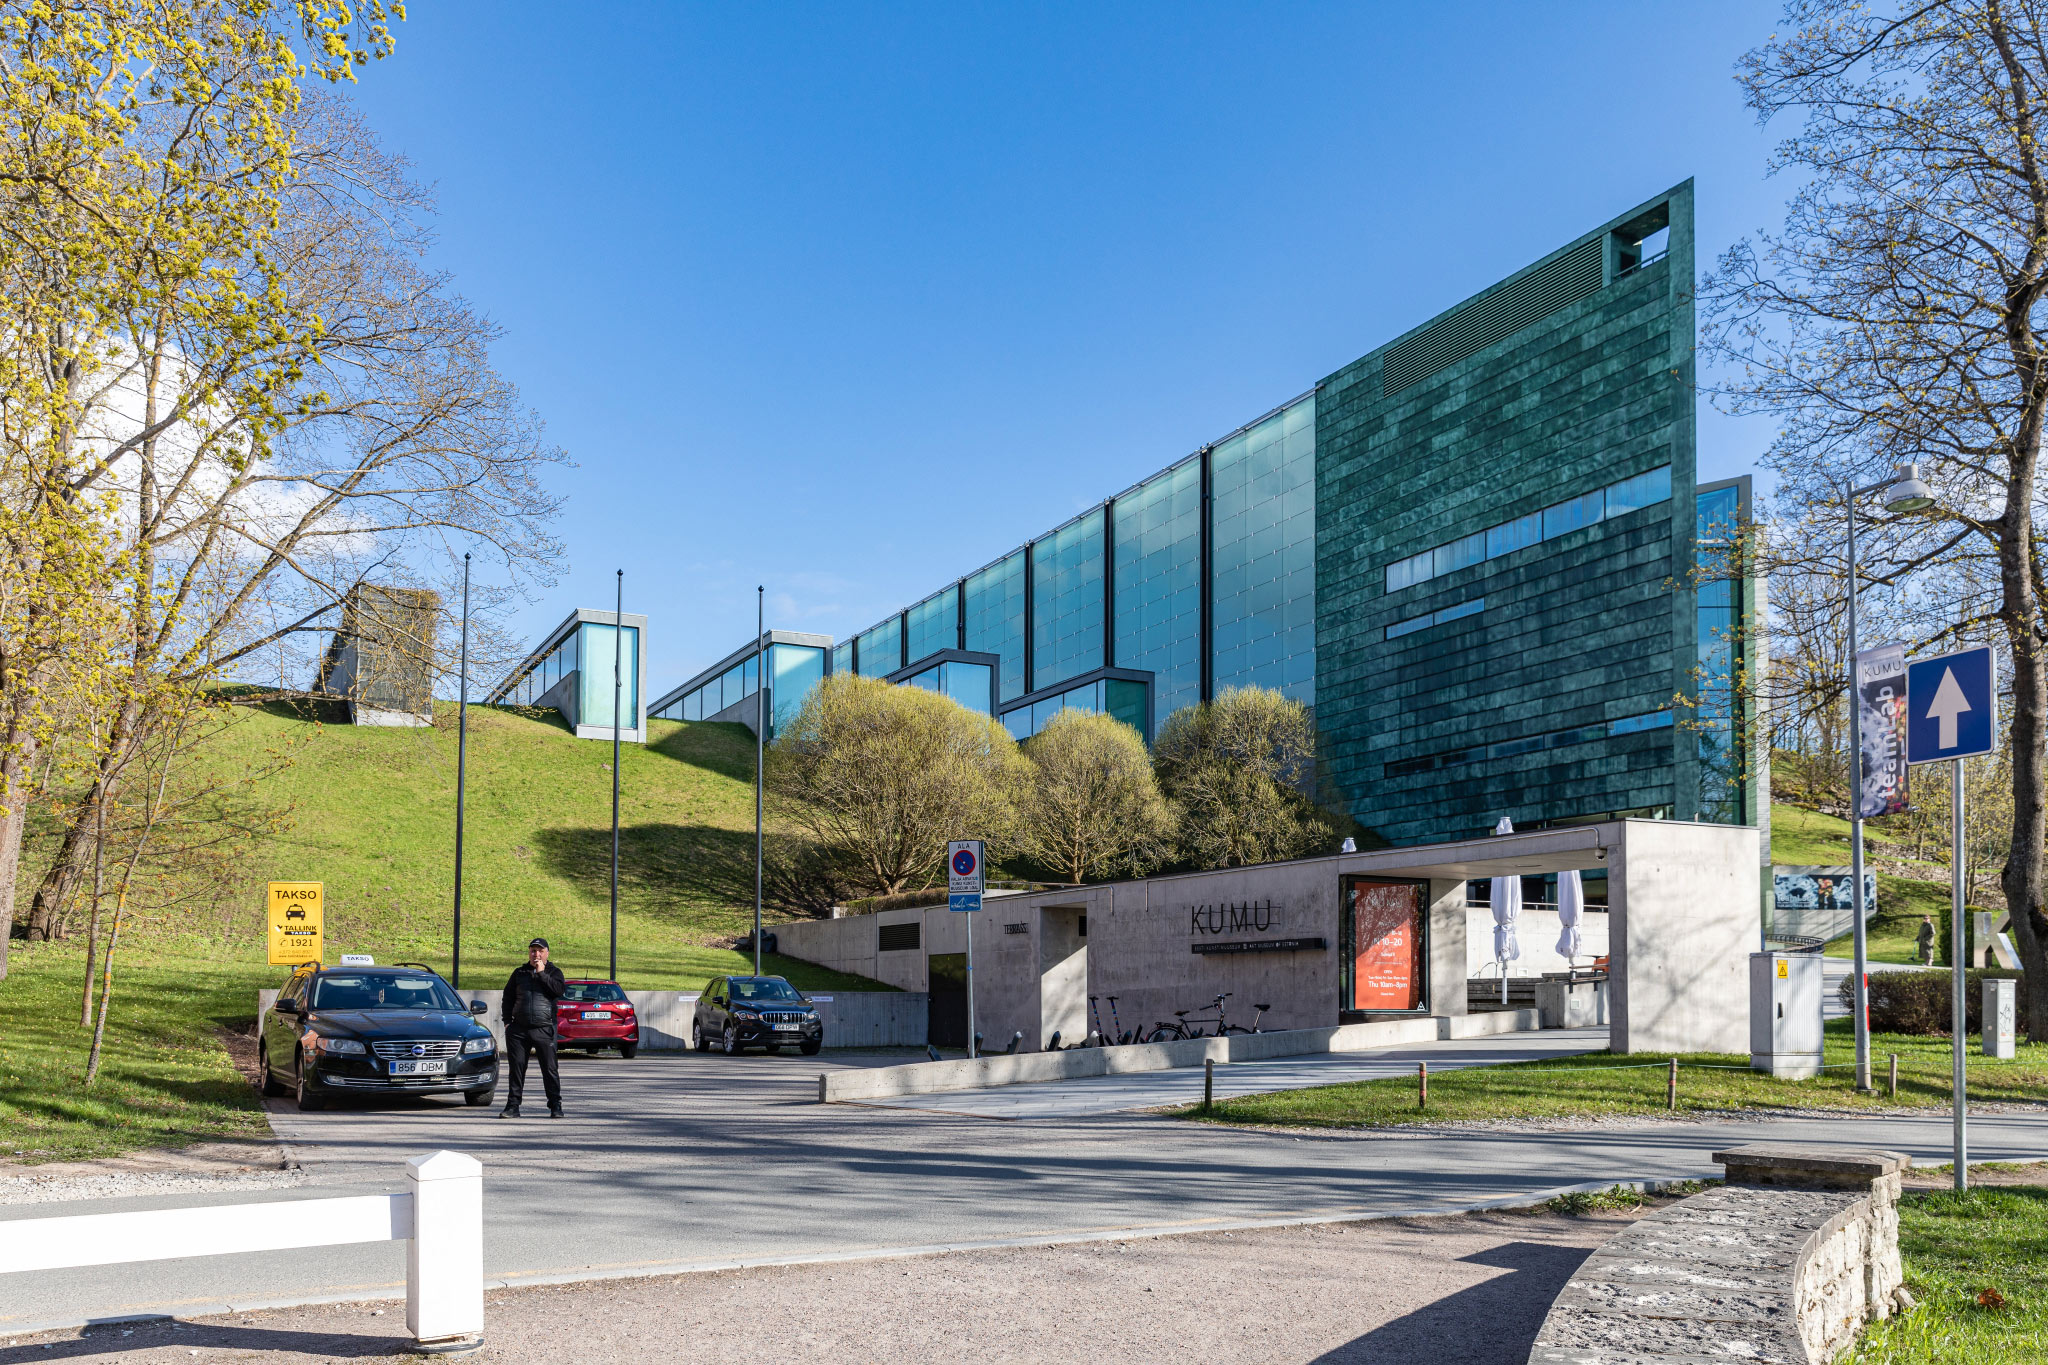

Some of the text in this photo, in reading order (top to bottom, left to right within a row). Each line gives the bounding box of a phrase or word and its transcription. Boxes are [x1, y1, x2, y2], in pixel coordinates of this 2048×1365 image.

[1864, 660, 1902, 677] KUMU
[1876, 685, 1897, 799] teamLab
[275, 890, 317, 900] TAKSO
[1191, 899, 1271, 935] KUMU
[290, 938, 313, 947] 1921
[398, 1062, 443, 1072] 856 DBM
